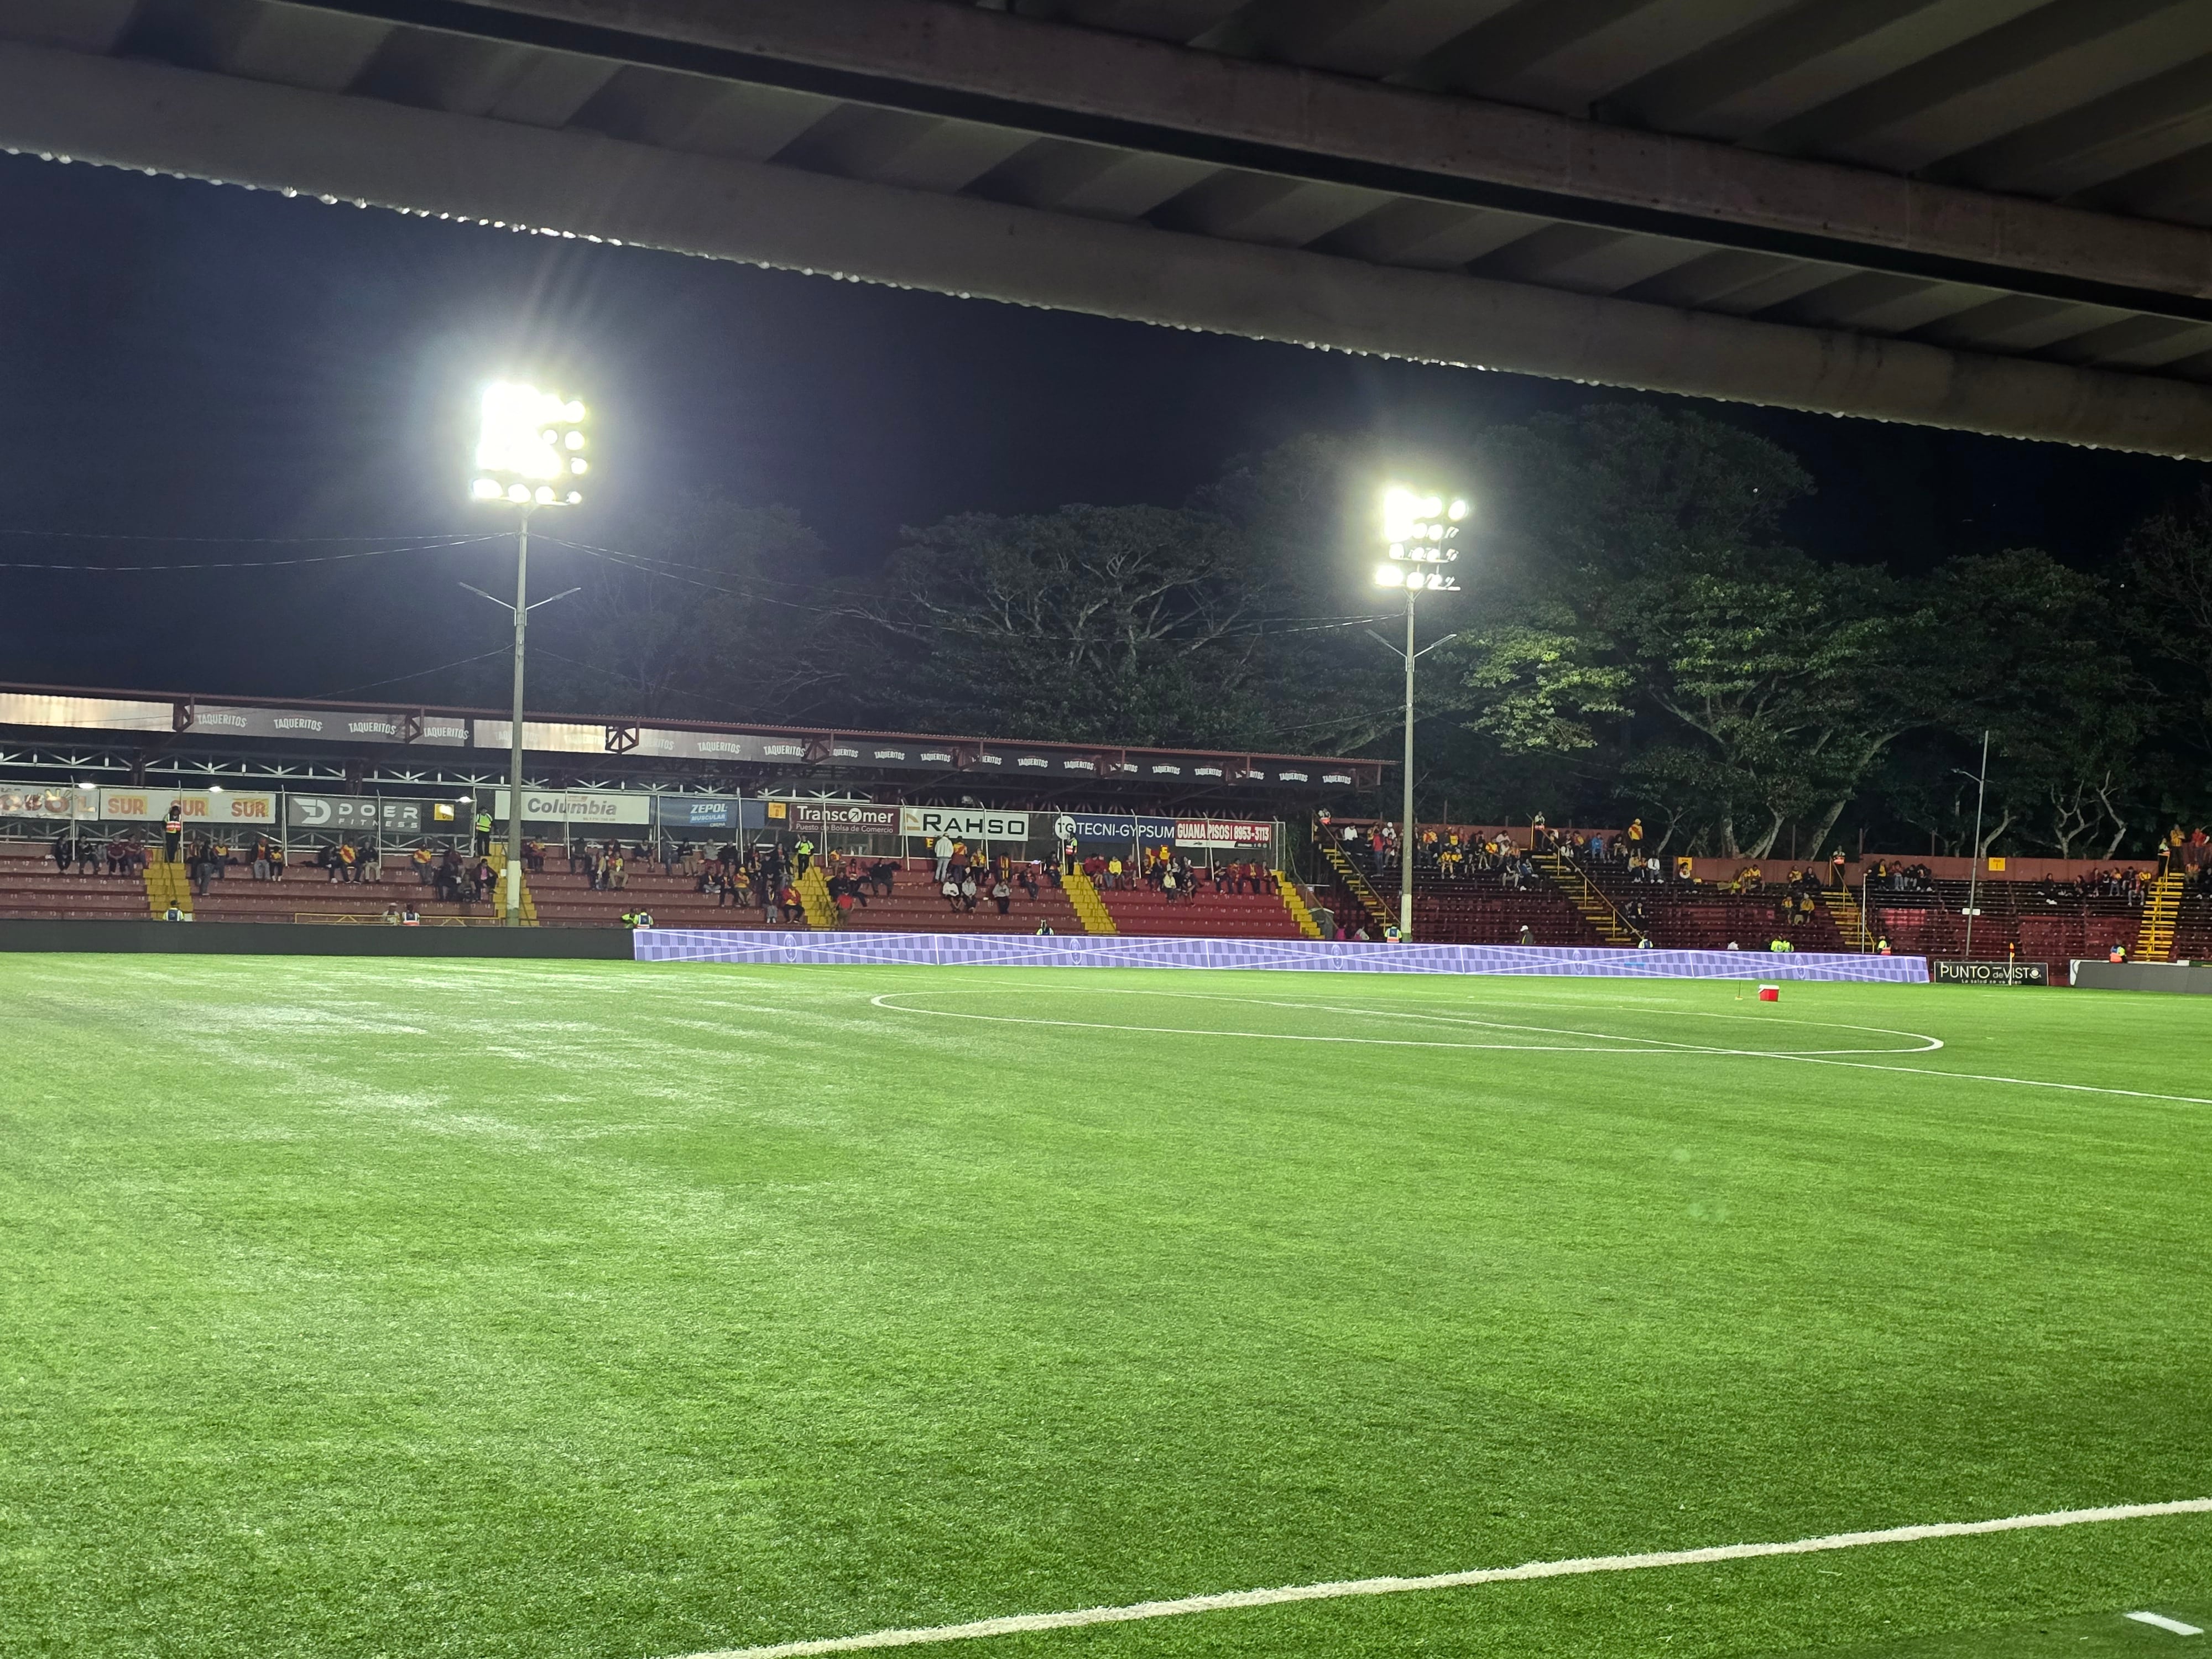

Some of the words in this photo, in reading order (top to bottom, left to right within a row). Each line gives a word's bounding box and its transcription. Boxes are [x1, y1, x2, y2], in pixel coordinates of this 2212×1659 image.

[197, 714, 247, 728] TAQUERITOS
[273, 718, 322, 731] TAQUERITOS
[348, 722, 397, 735] TAQUERITOS
[424, 727, 469, 740] TAQUERITOS
[697, 742, 741, 754] TAQUERITOS
[763, 745, 806, 757] TAQUERITOS
[833, 748, 859, 758] QUERITOS
[874, 751, 905, 760] TAQUERITOS
[921, 753, 951, 763] TAQUERITOS
[1018, 758, 1048, 768] TAQUERITOS
[1064, 760, 1095, 771] TAQUERITOS
[1152, 765, 1180, 775] TAQUERITOS
[1194, 768, 1222, 777] TAQUERITOS
[1279, 773, 1308, 782] TAQUERITOS
[1322, 775, 1352, 785] TAQUERITOS
[108, 798, 144, 815] SUR
[231, 801, 267, 817] SUR
[339, 804, 418, 819] DOER
[528, 798, 617, 815] Columbia
[691, 804, 727, 813] ZEPOL
[338, 818, 418, 829] FITNESS
[923, 813, 1024, 834] RAHSO
[1058, 822, 1074, 833] TG
[1077, 822, 1175, 838] TECNI-GYPSUM
[1177, 823, 1206, 839] GUANA
[1207, 824, 1230, 839] PISOS
[1940, 964, 1990, 979] PUNTO
